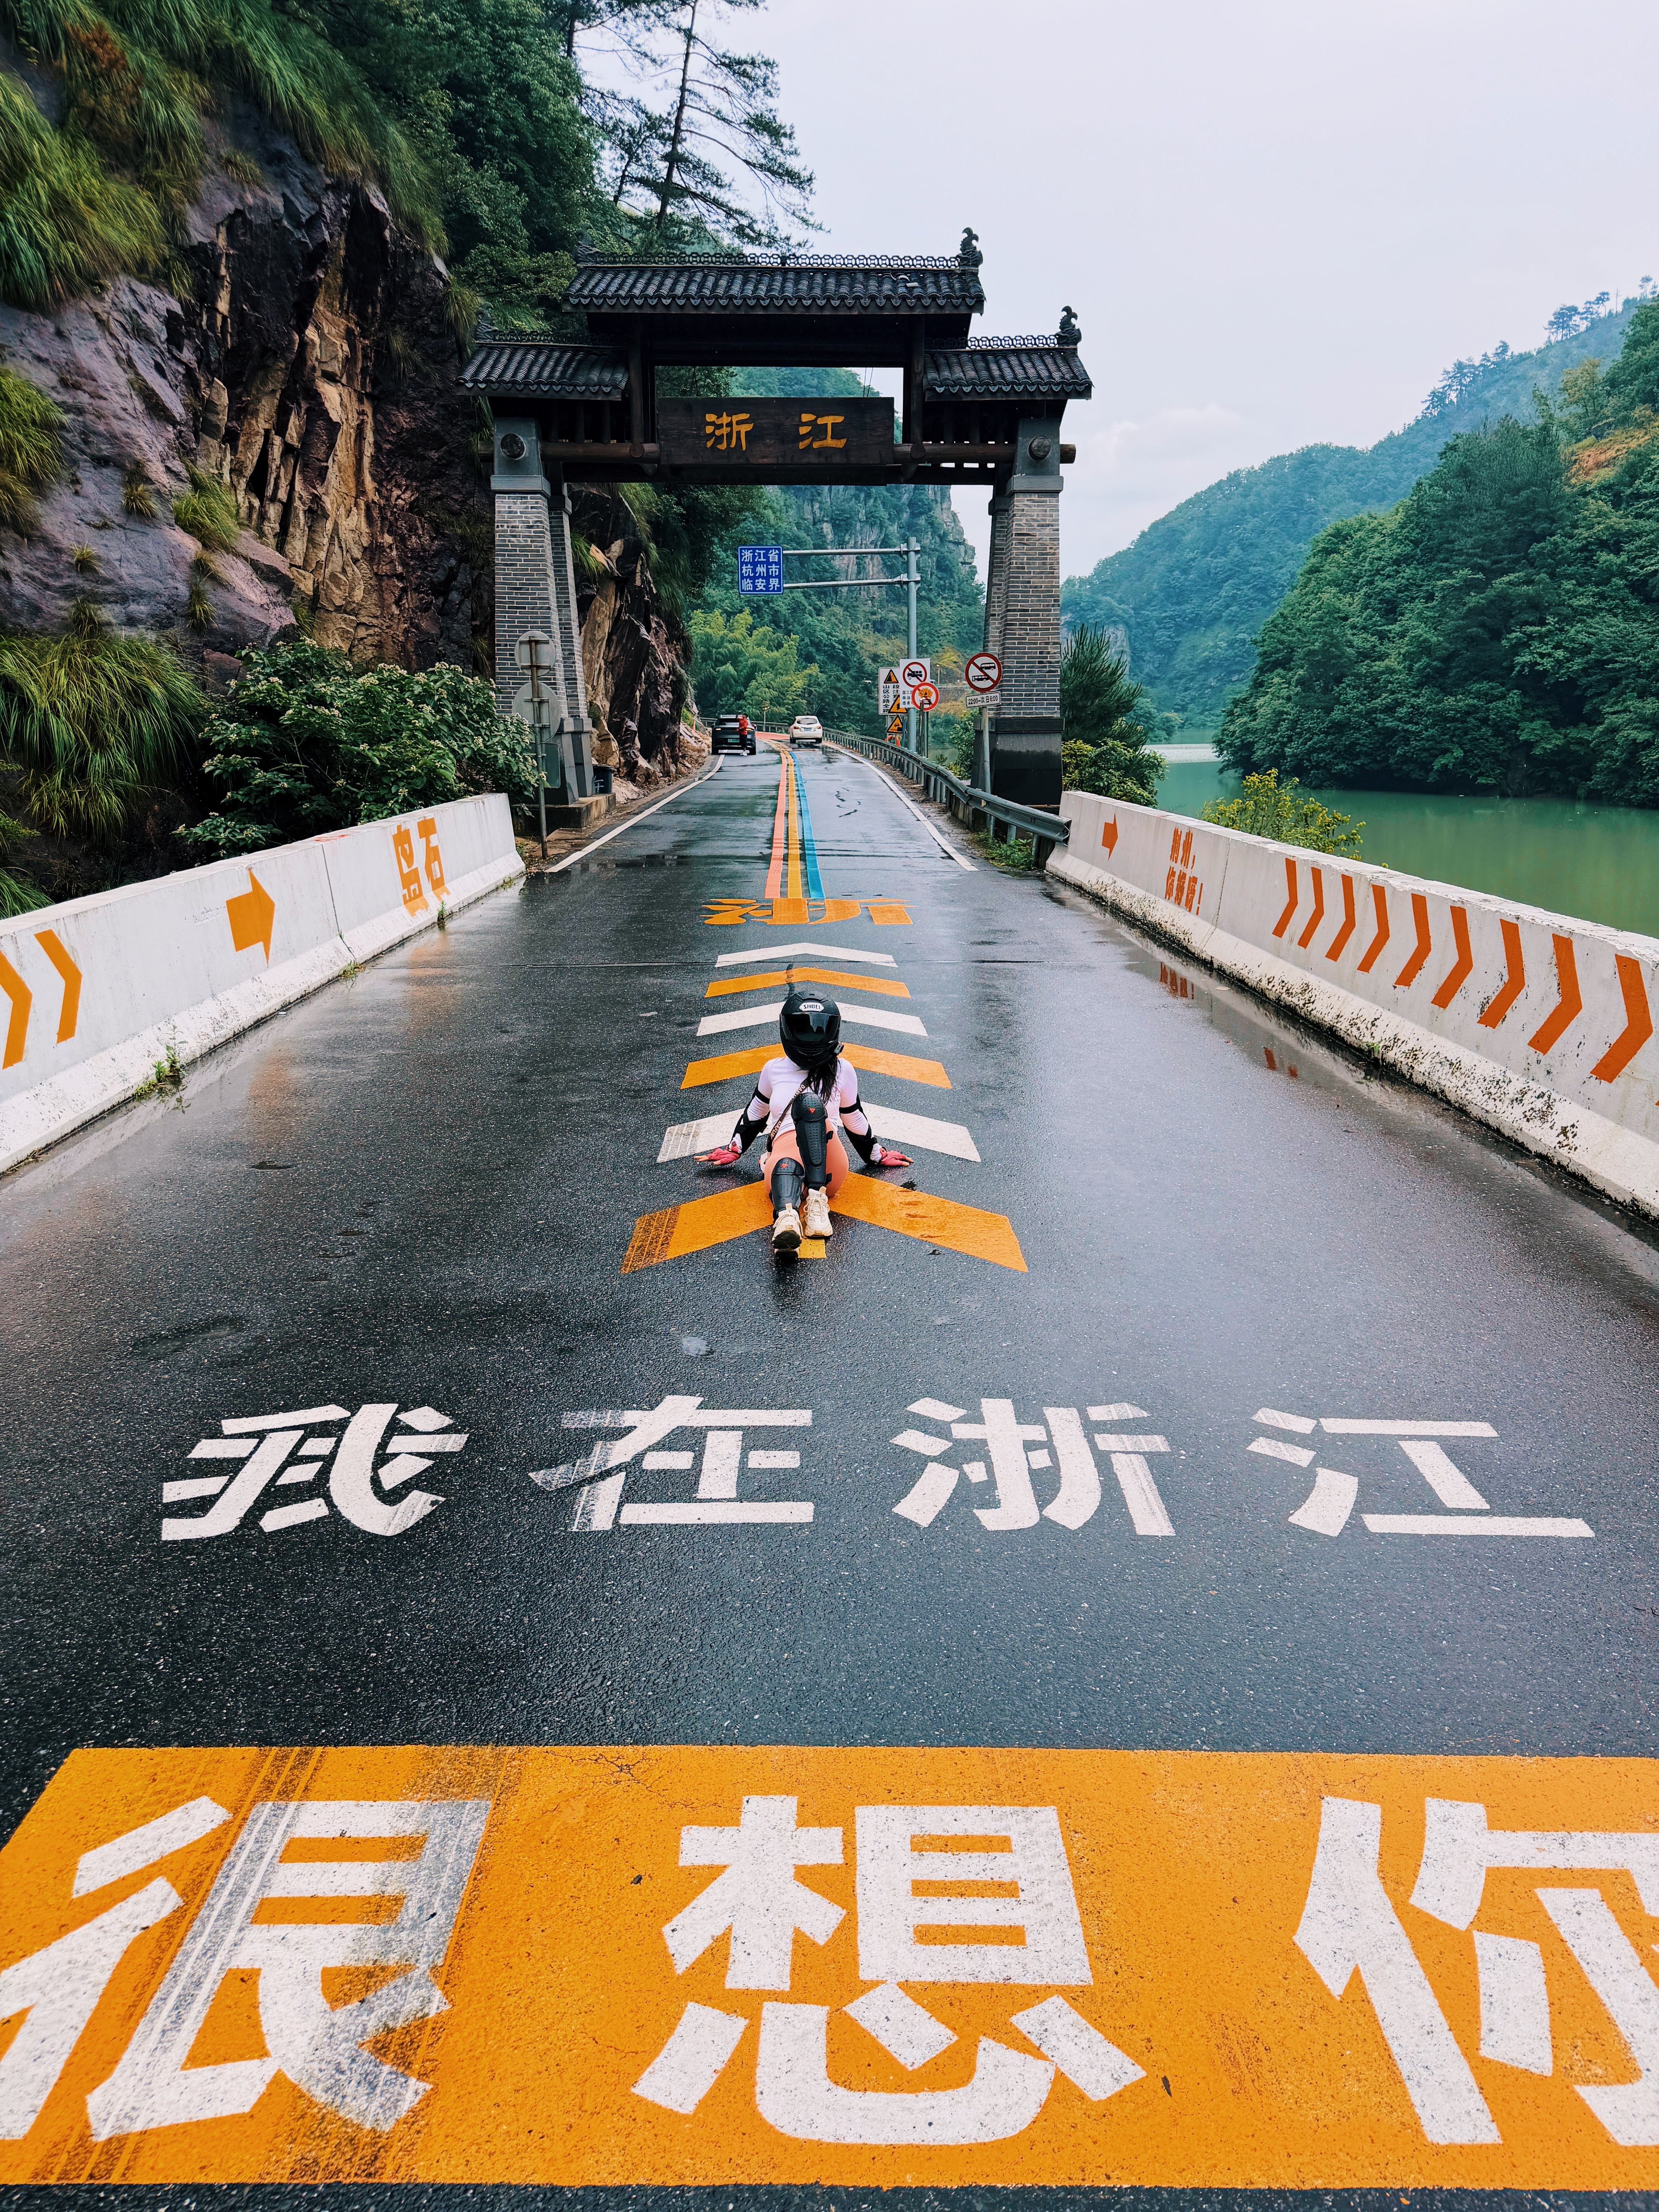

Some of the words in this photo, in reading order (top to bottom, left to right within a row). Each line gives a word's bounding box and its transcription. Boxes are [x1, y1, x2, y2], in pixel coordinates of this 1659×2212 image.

[705, 411, 847, 451] 浙江
[741, 549, 780, 562] 浙江省
[742, 564, 780, 577] 杭州市
[742, 578, 780, 591] 临安界
[392, 817, 451, 917] 岛石
[699, 897, 918, 926] 浙
[161, 1395, 1595, 1541] 我在浙江
[0, 1795, 1659, 2146] 很想你
